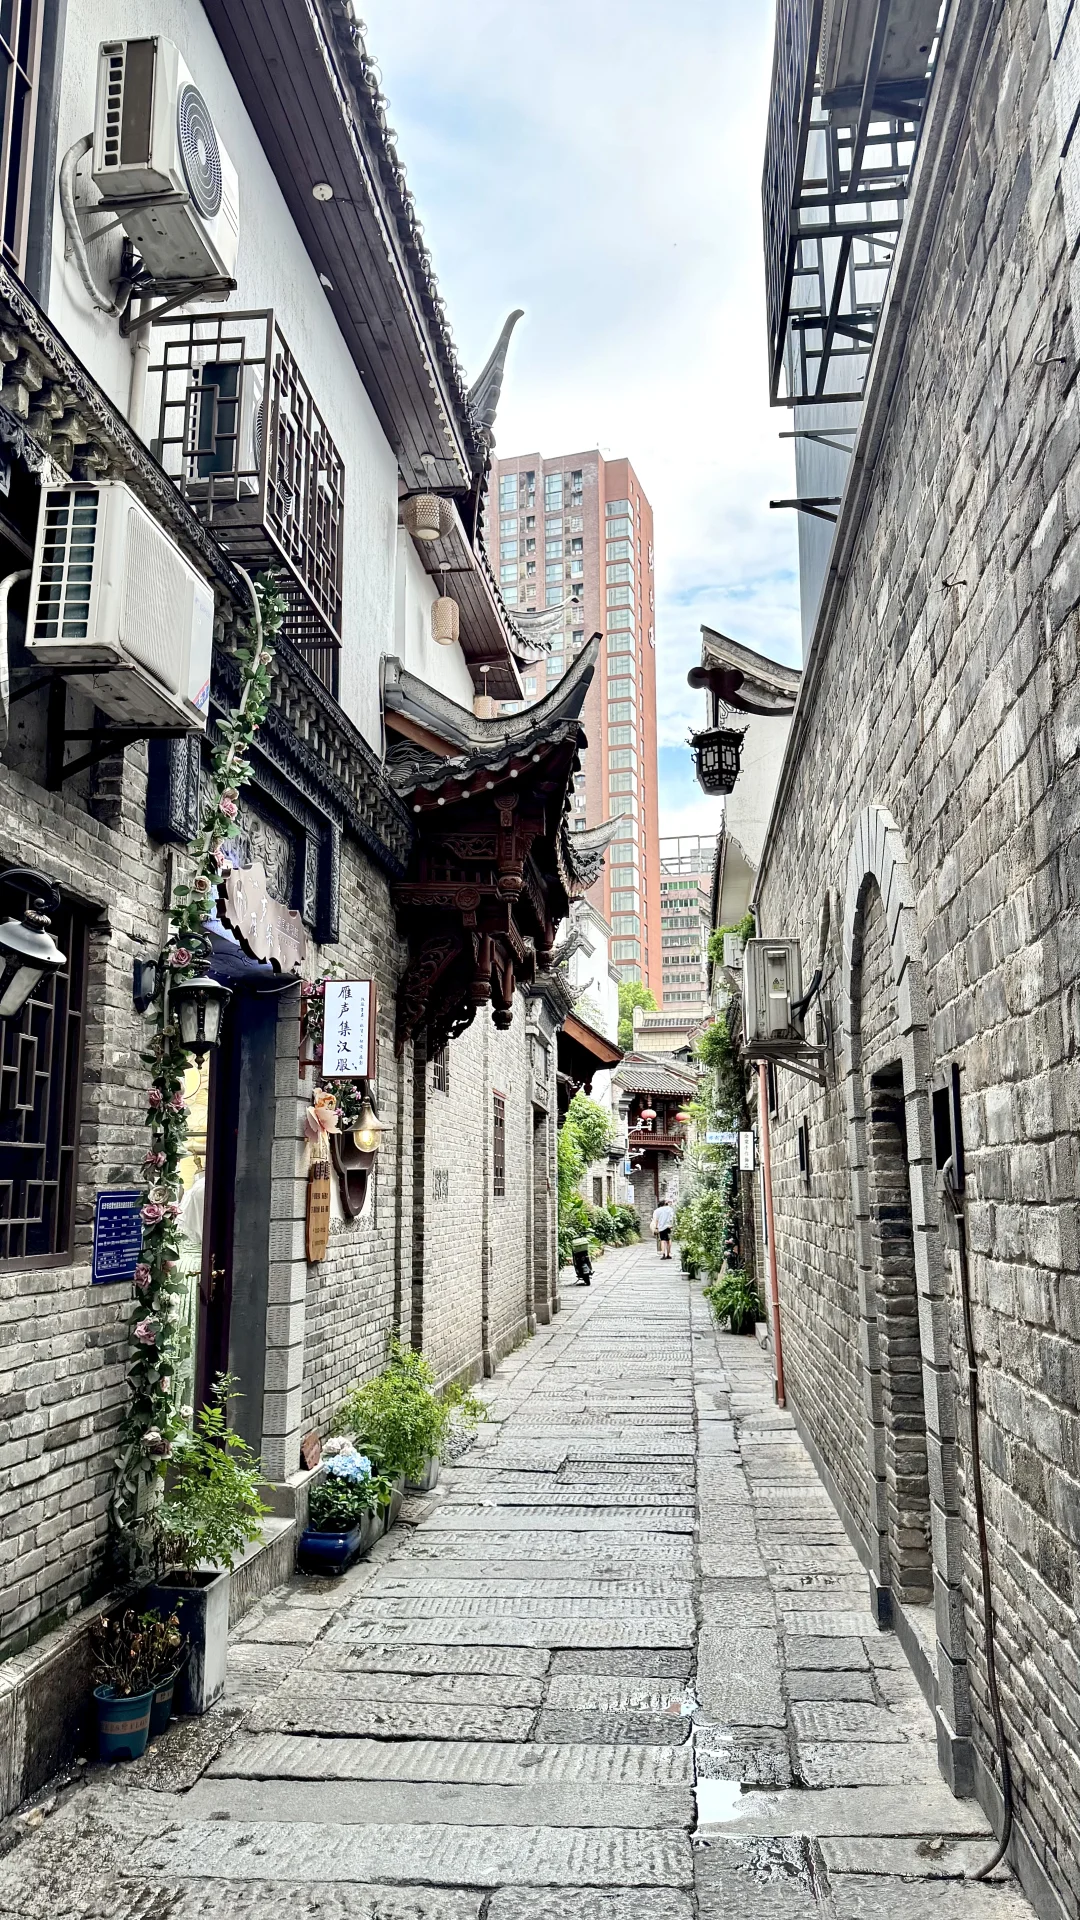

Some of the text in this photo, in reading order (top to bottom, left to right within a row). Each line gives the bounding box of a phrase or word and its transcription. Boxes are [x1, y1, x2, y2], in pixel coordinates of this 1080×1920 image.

[335, 985, 353, 1072] 雁声集汉服
